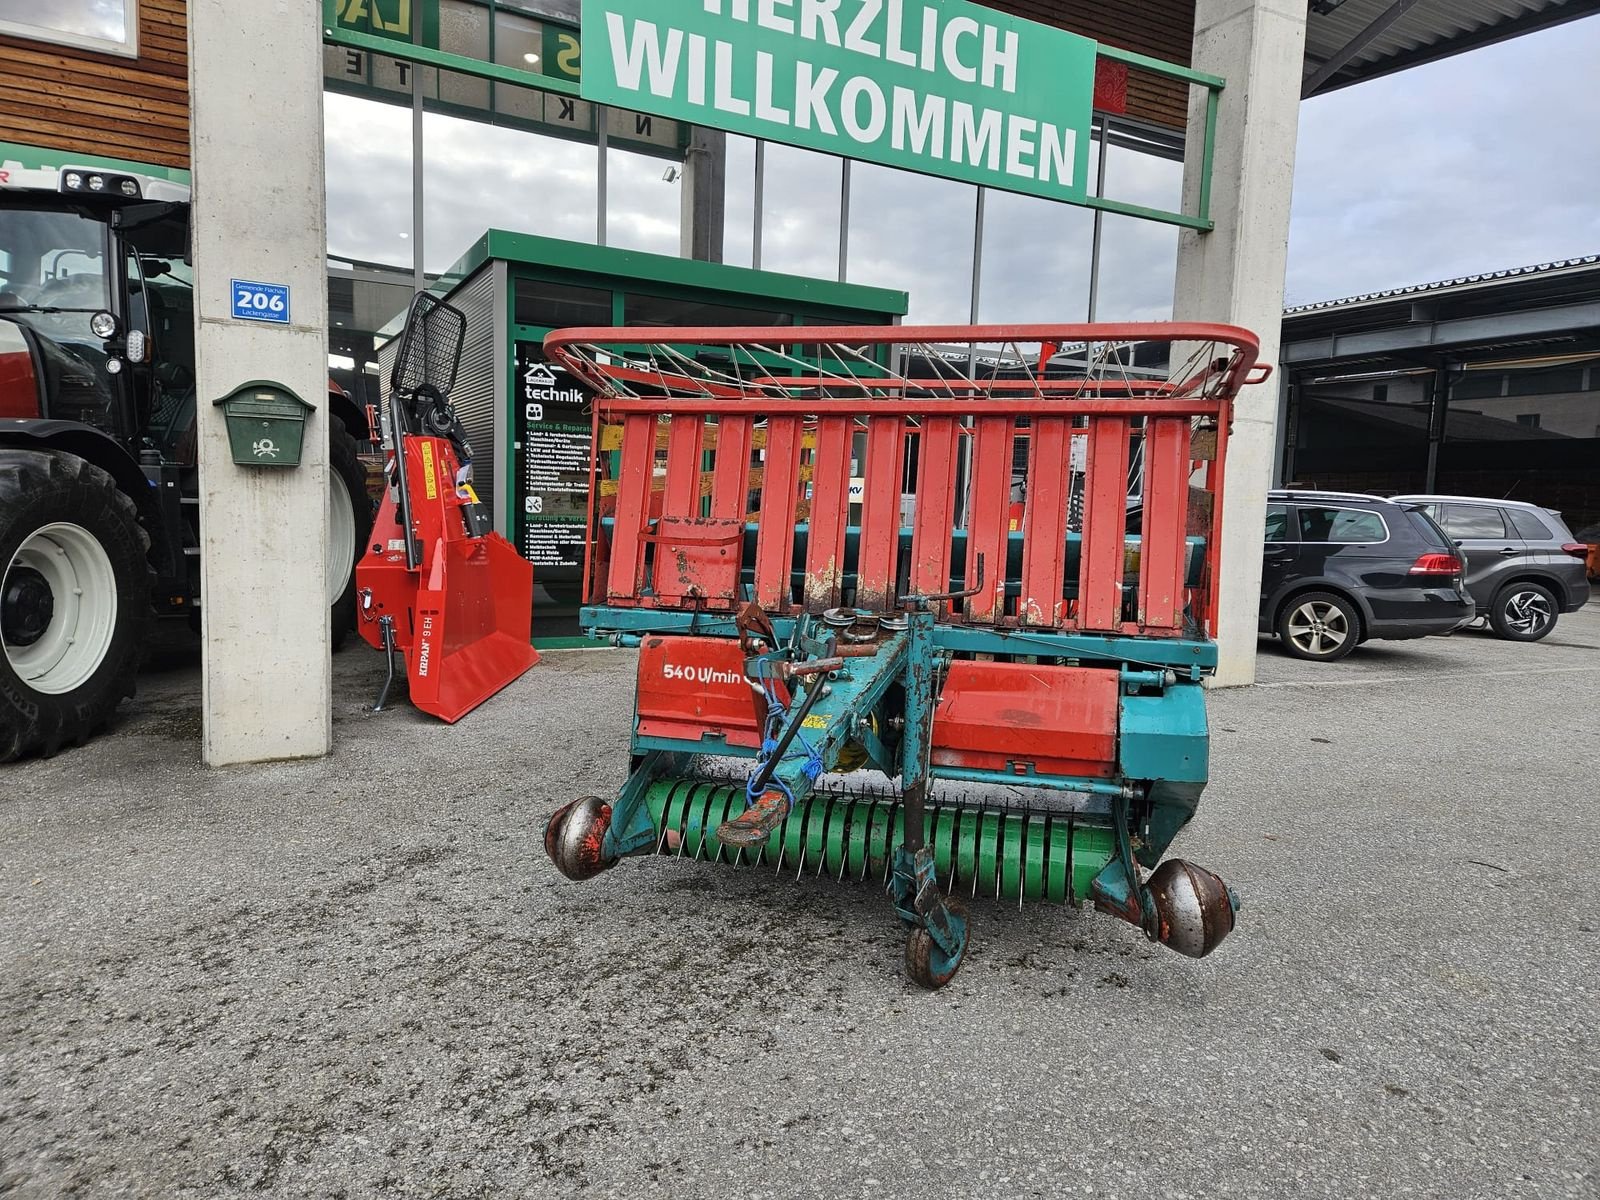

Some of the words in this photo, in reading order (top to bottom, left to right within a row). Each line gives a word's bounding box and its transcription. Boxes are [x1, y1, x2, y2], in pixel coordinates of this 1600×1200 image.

[703, 0, 1019, 93] RZLICH
[605, 11, 1077, 187] WILLKOMMEN
[235, 283, 264, 291] Gemeinde
[264, 287, 286, 295] Flachau
[237, 290, 284, 312] 206
[242, 309, 280, 318] Lackengasse
[524, 385, 583, 403] technik
[526, 421, 553, 430] Service
[555, 423, 561, 431] &
[526, 514, 558, 523] Beratung
[423, 617, 433, 629] EH
[418, 641, 430, 677] KRPAN
[663, 664, 696, 681] 540
[697, 666, 741, 684] U/min
